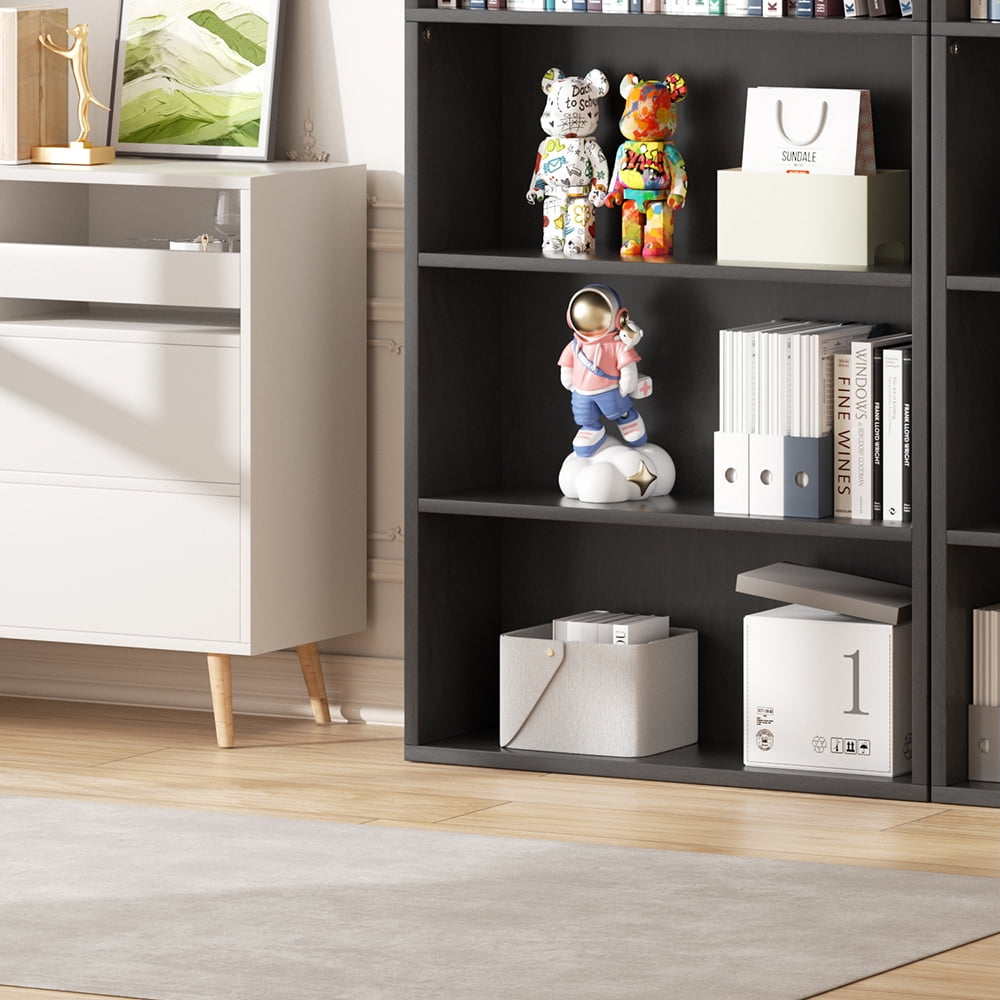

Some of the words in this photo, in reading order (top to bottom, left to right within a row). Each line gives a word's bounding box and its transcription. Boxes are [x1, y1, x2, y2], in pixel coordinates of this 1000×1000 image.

[565, 97, 577, 109] to
[781, 150, 817, 163] SUNDALE
[838, 376, 850, 421] FINE
[855, 348, 868, 420] WINDOWS
[838, 430, 850, 496] WINES
[843, 649, 869, 715] 1
